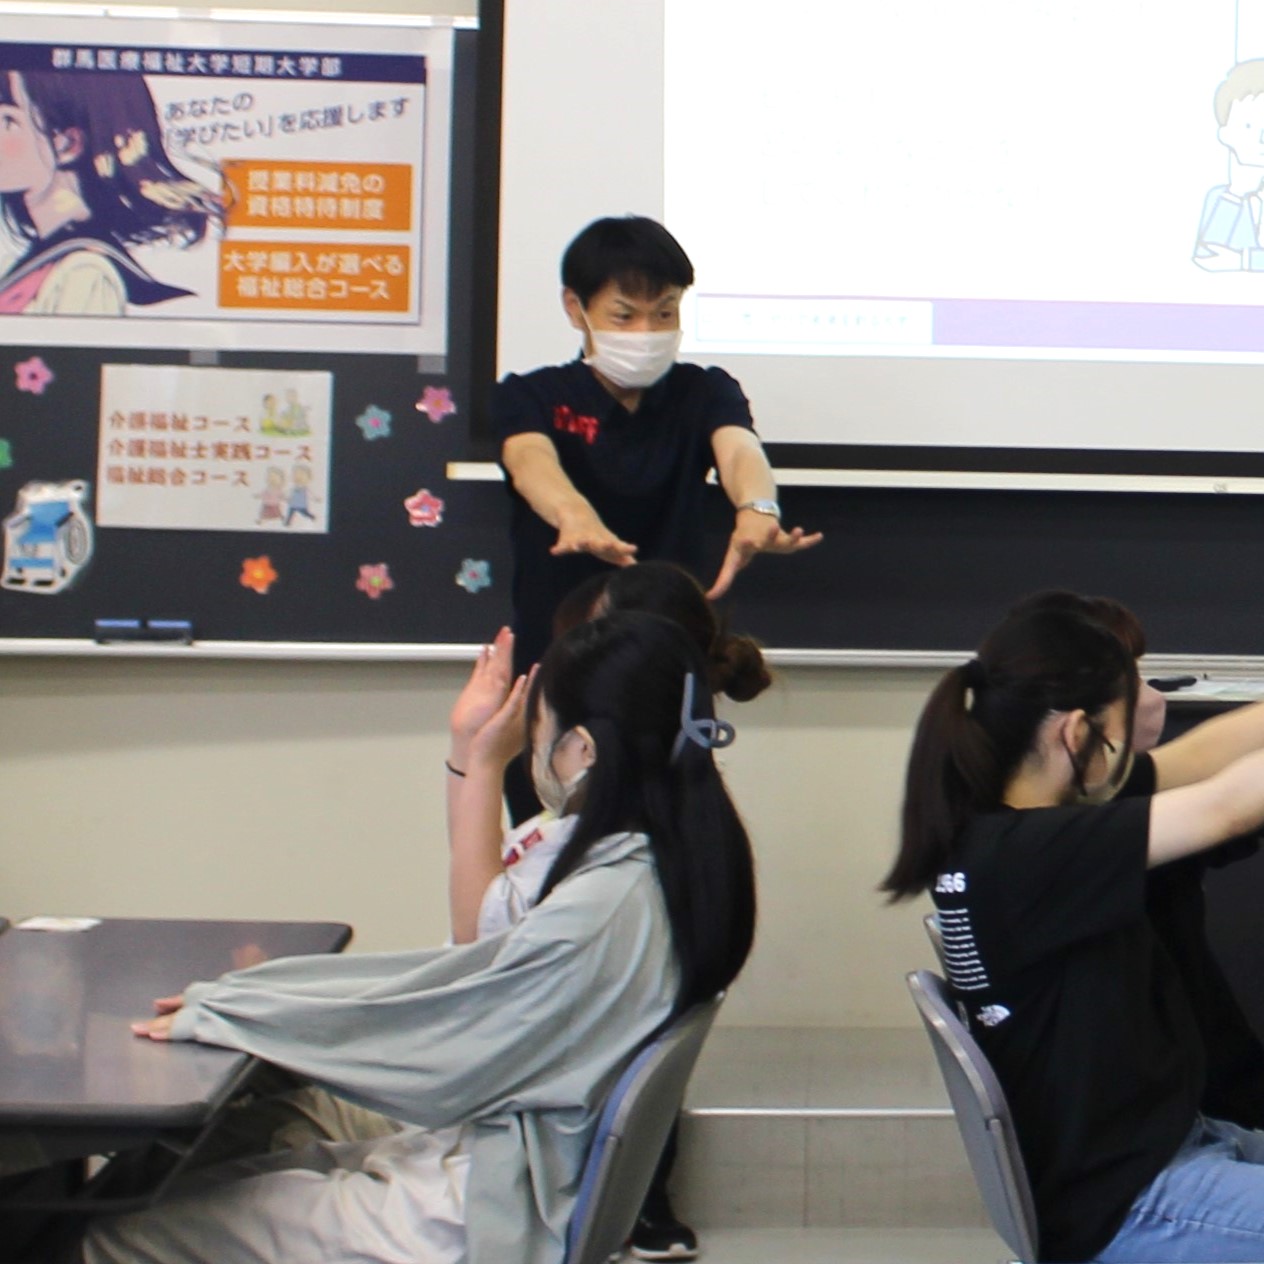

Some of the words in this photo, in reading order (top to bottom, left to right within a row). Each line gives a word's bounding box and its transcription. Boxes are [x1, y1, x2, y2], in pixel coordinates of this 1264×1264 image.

[51, 48, 342, 77] 群馬医療福祉大学短期大学部
[166, 92, 253, 121] あなたの
[237, 275, 390, 300] 福祉総合コース
[109, 411, 251, 432] 介護福祉コース
[109, 439, 311, 461] 介護福祉士実践コース
[107, 467, 249, 486] 福祉総合コース
